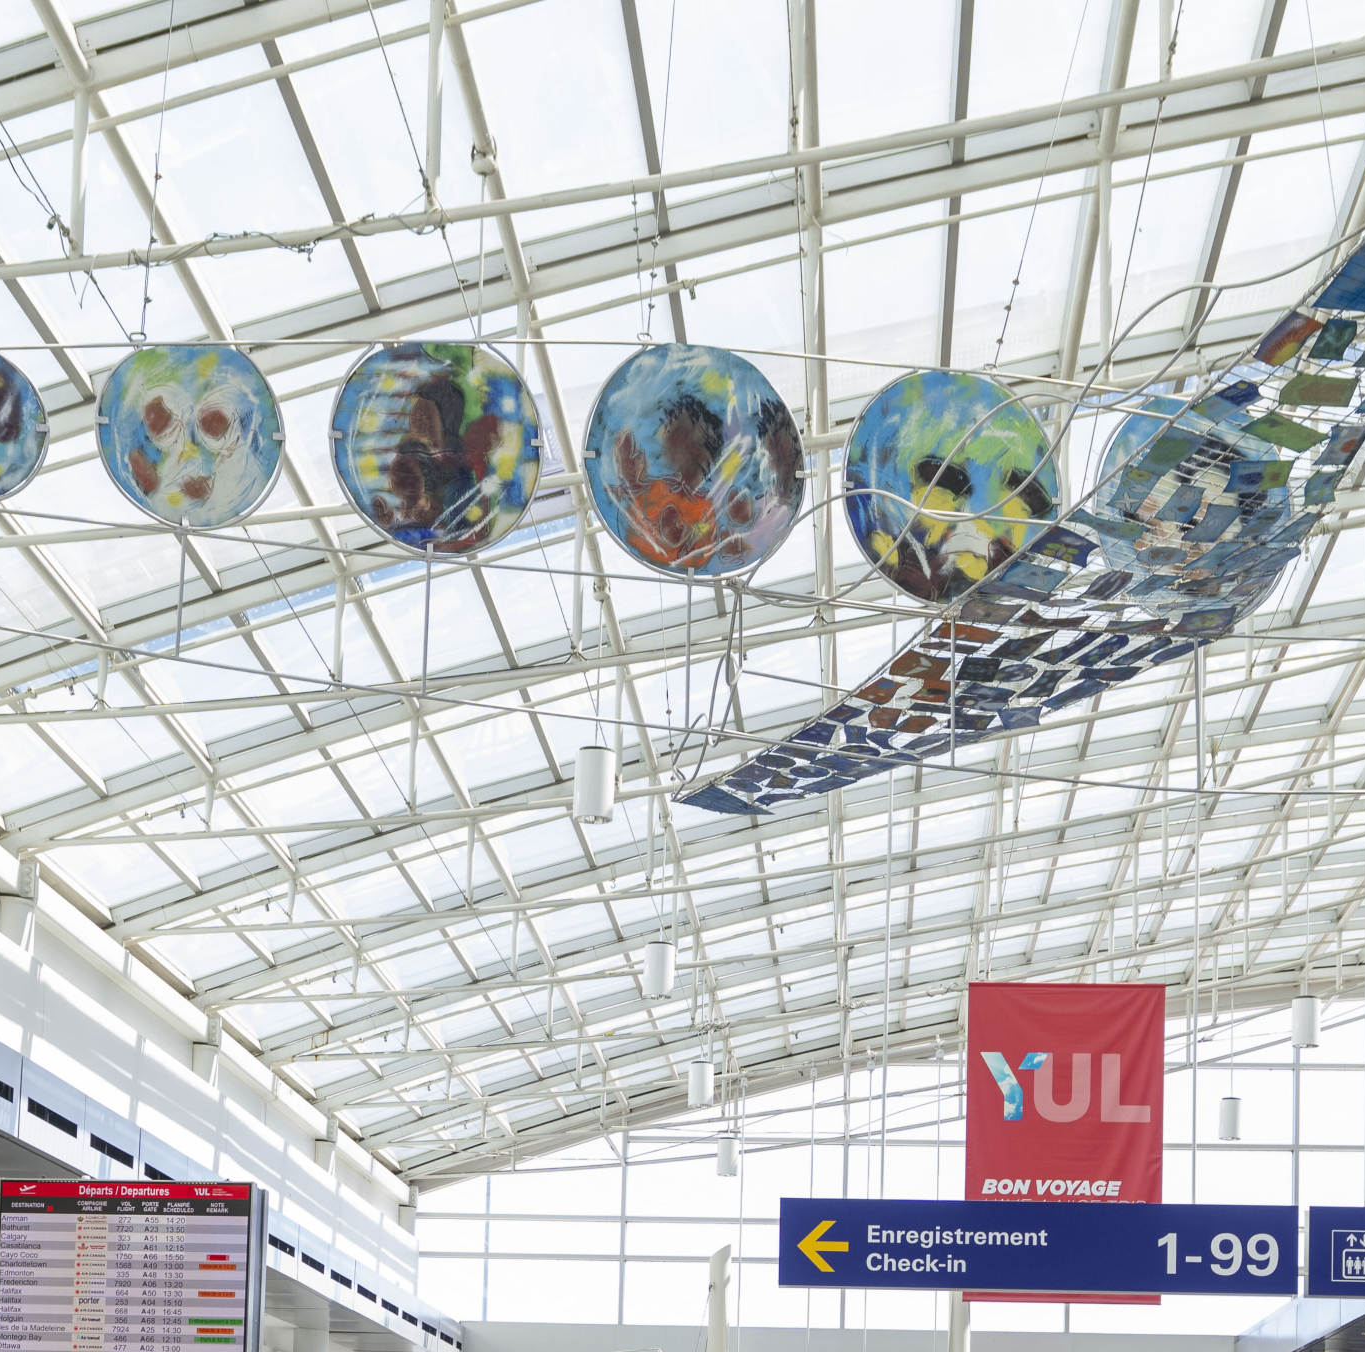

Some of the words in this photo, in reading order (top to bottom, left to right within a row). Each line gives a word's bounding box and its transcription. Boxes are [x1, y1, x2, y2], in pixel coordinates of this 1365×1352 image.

[980, 1051, 1151, 1123] YUL
[79, 1186, 113, 1197] Départs
[121, 1186, 169, 1197] Departures
[194, 1187, 210, 1197] YUL
[981, 1178, 1031, 1195] BON
[1035, 1179, 1123, 1197] VOYAGE
[0, 1233, 27, 1242] Calgary
[868, 1225, 1047, 1248] Enregistrement
[867, 1253, 966, 1272] Check-in
[1158, 1233, 1278, 1276] 1-99
[78, 1297, 100, 1306] porter
